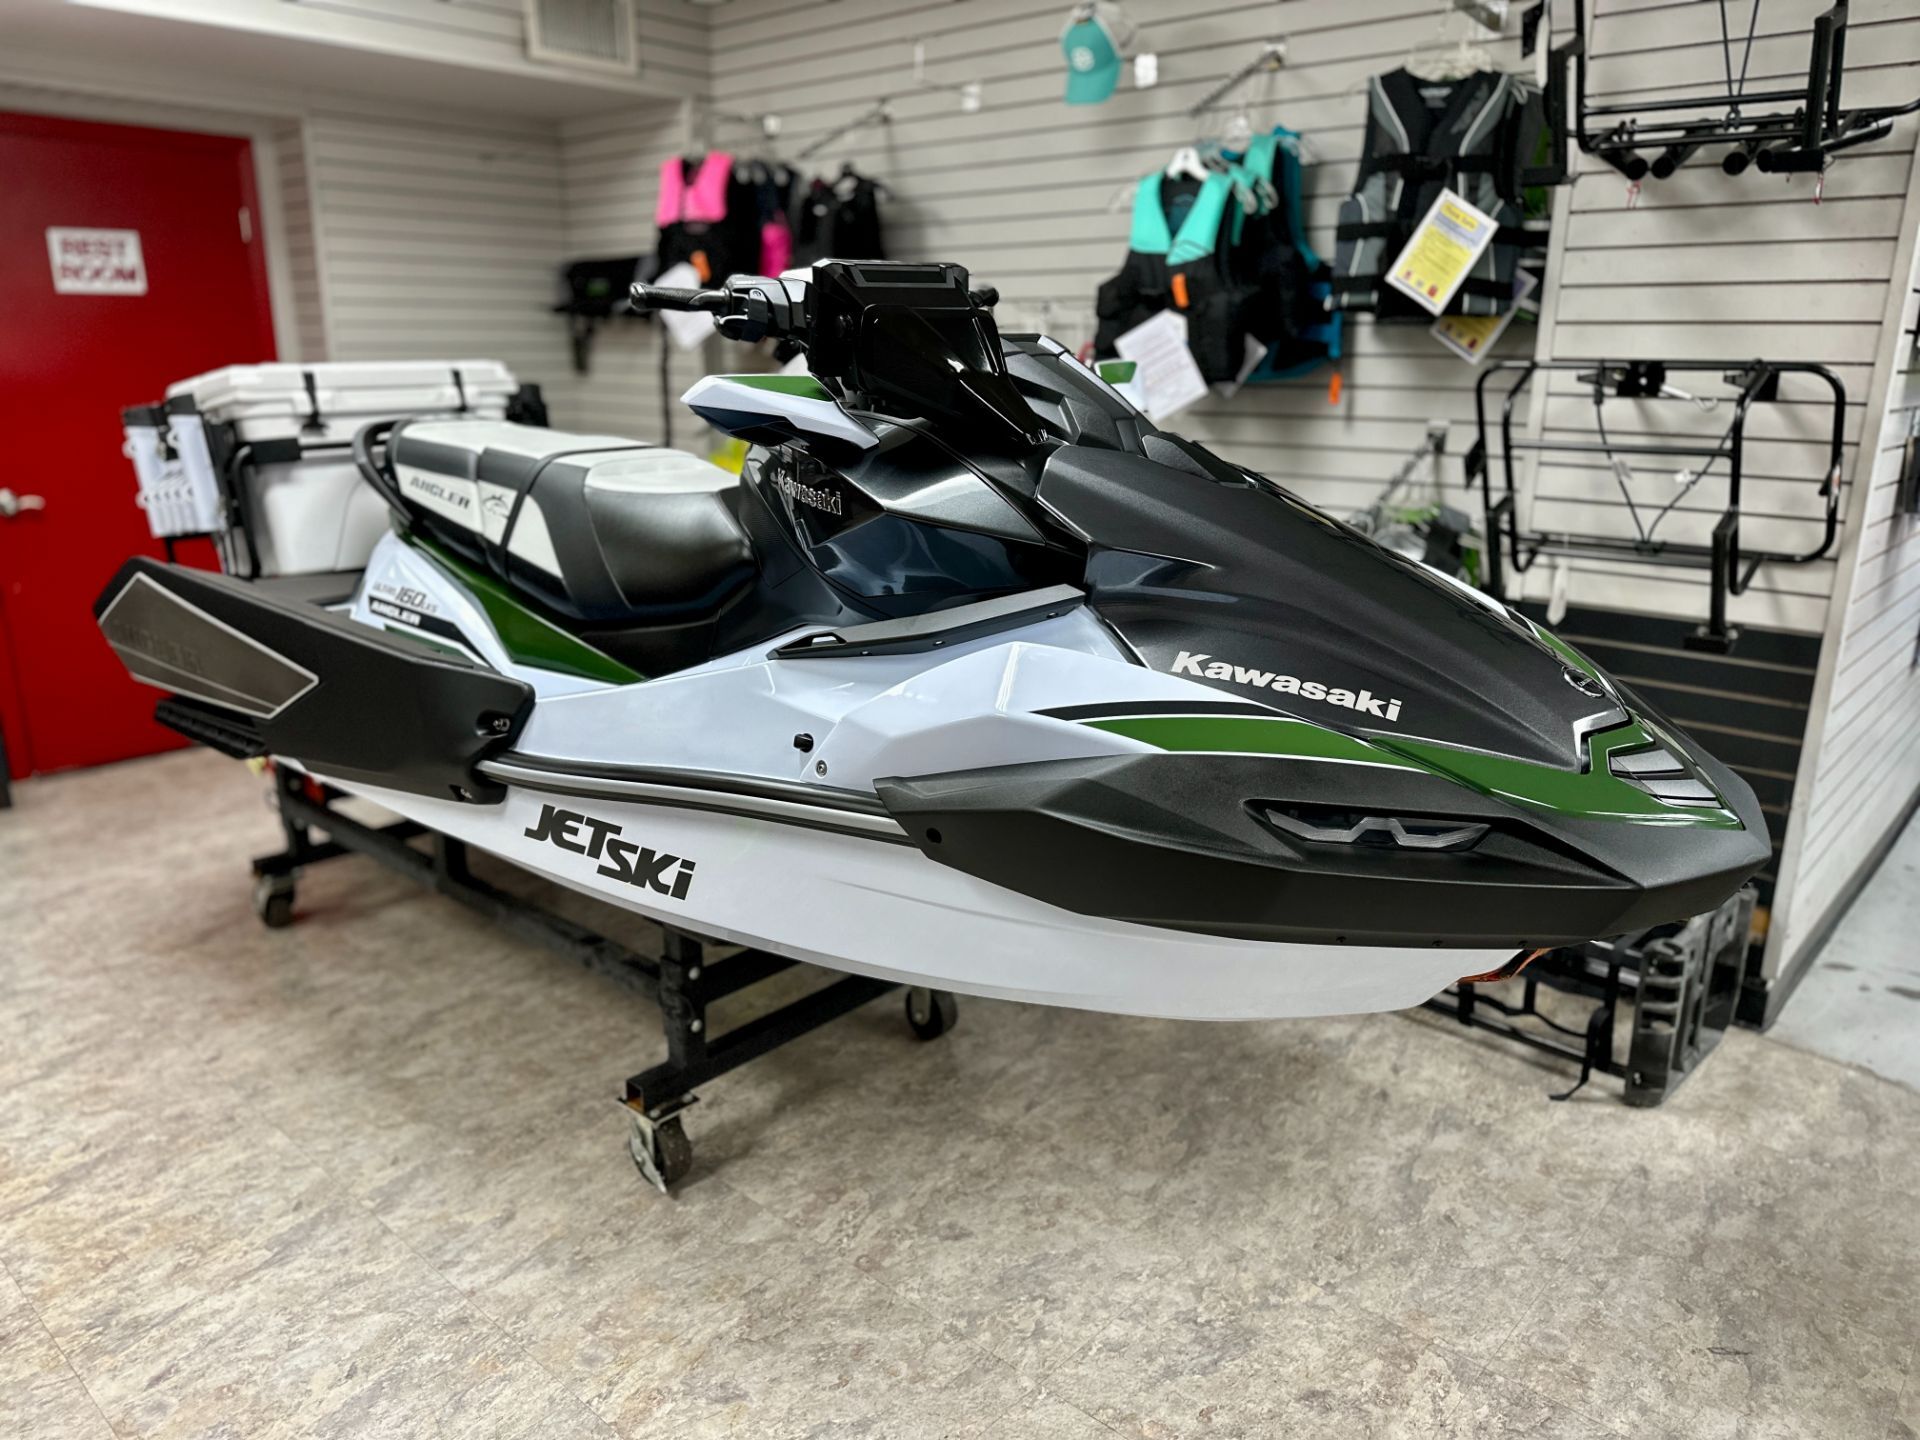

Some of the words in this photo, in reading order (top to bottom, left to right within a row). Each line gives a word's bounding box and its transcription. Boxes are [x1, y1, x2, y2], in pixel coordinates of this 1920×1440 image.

[410, 477, 470, 509] ANGLER
[777, 467, 842, 516] Kawasaki
[1170, 650, 1402, 722] Kawasaki
